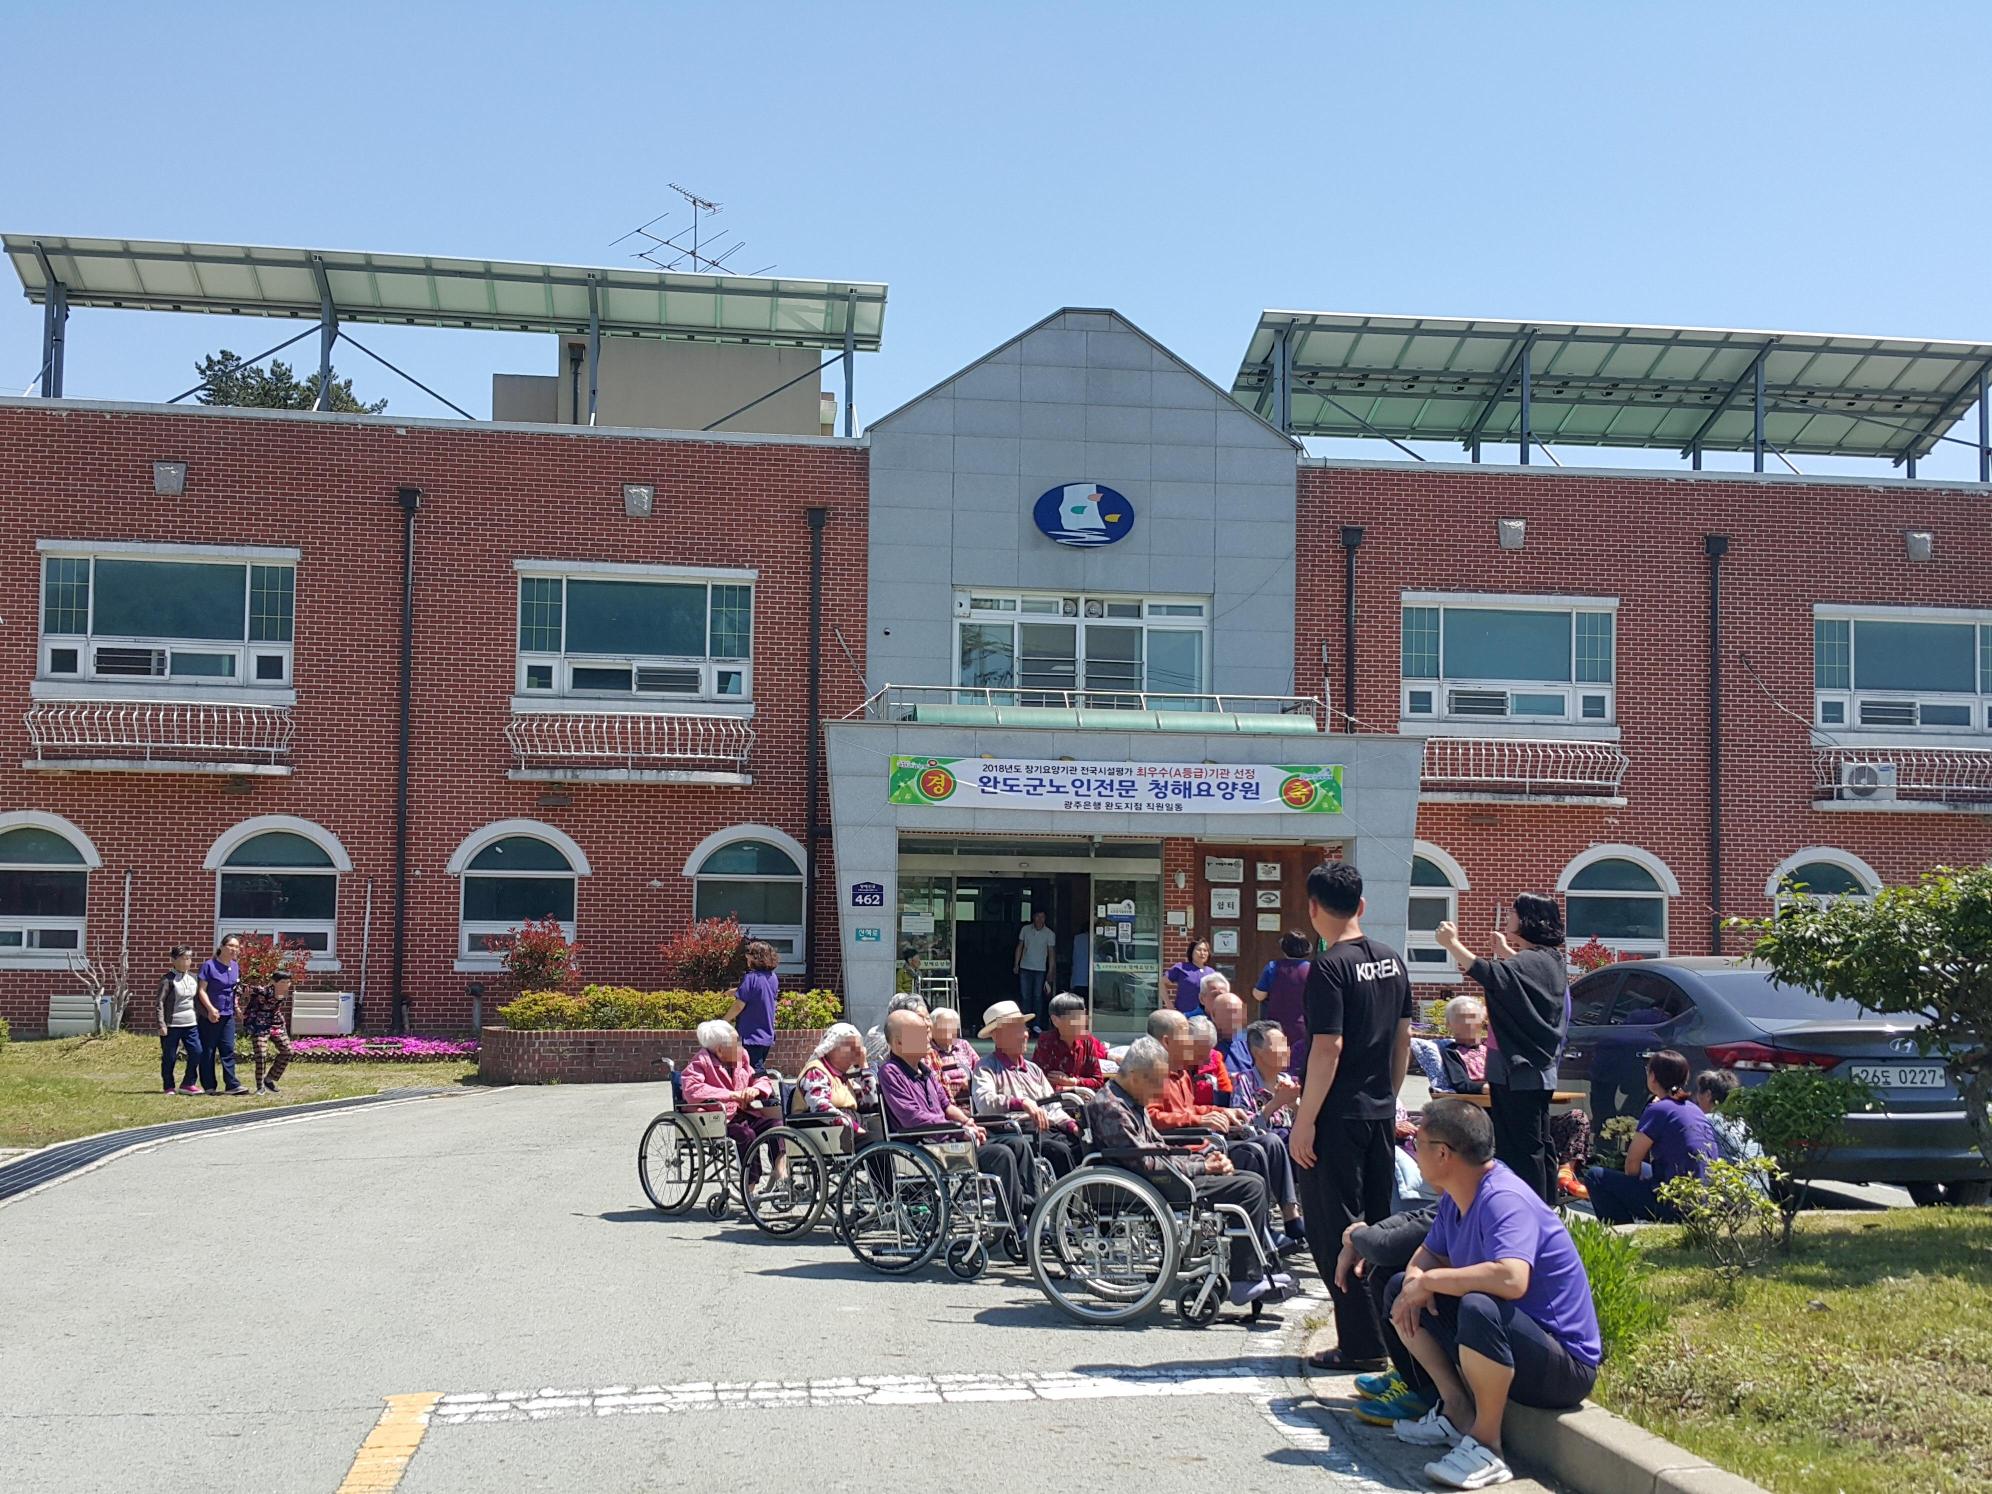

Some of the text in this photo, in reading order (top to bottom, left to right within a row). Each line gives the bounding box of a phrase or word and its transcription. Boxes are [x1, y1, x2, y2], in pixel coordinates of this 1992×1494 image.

[982, 764, 1256, 780] 2018년도 장기요양기관 전국시설평가 최우수(A등급)기관 선정
[927, 773, 945, 794] 경
[978, 775, 1261, 801] 완도군노인전문 청해요양원
[1064, 801, 1184, 812] 광주은행 완도지점 직원일동
[855, 894, 881, 905] 462
[1355, 958, 1401, 982] KOREA
[1898, 1069, 1937, 1085] 0227
